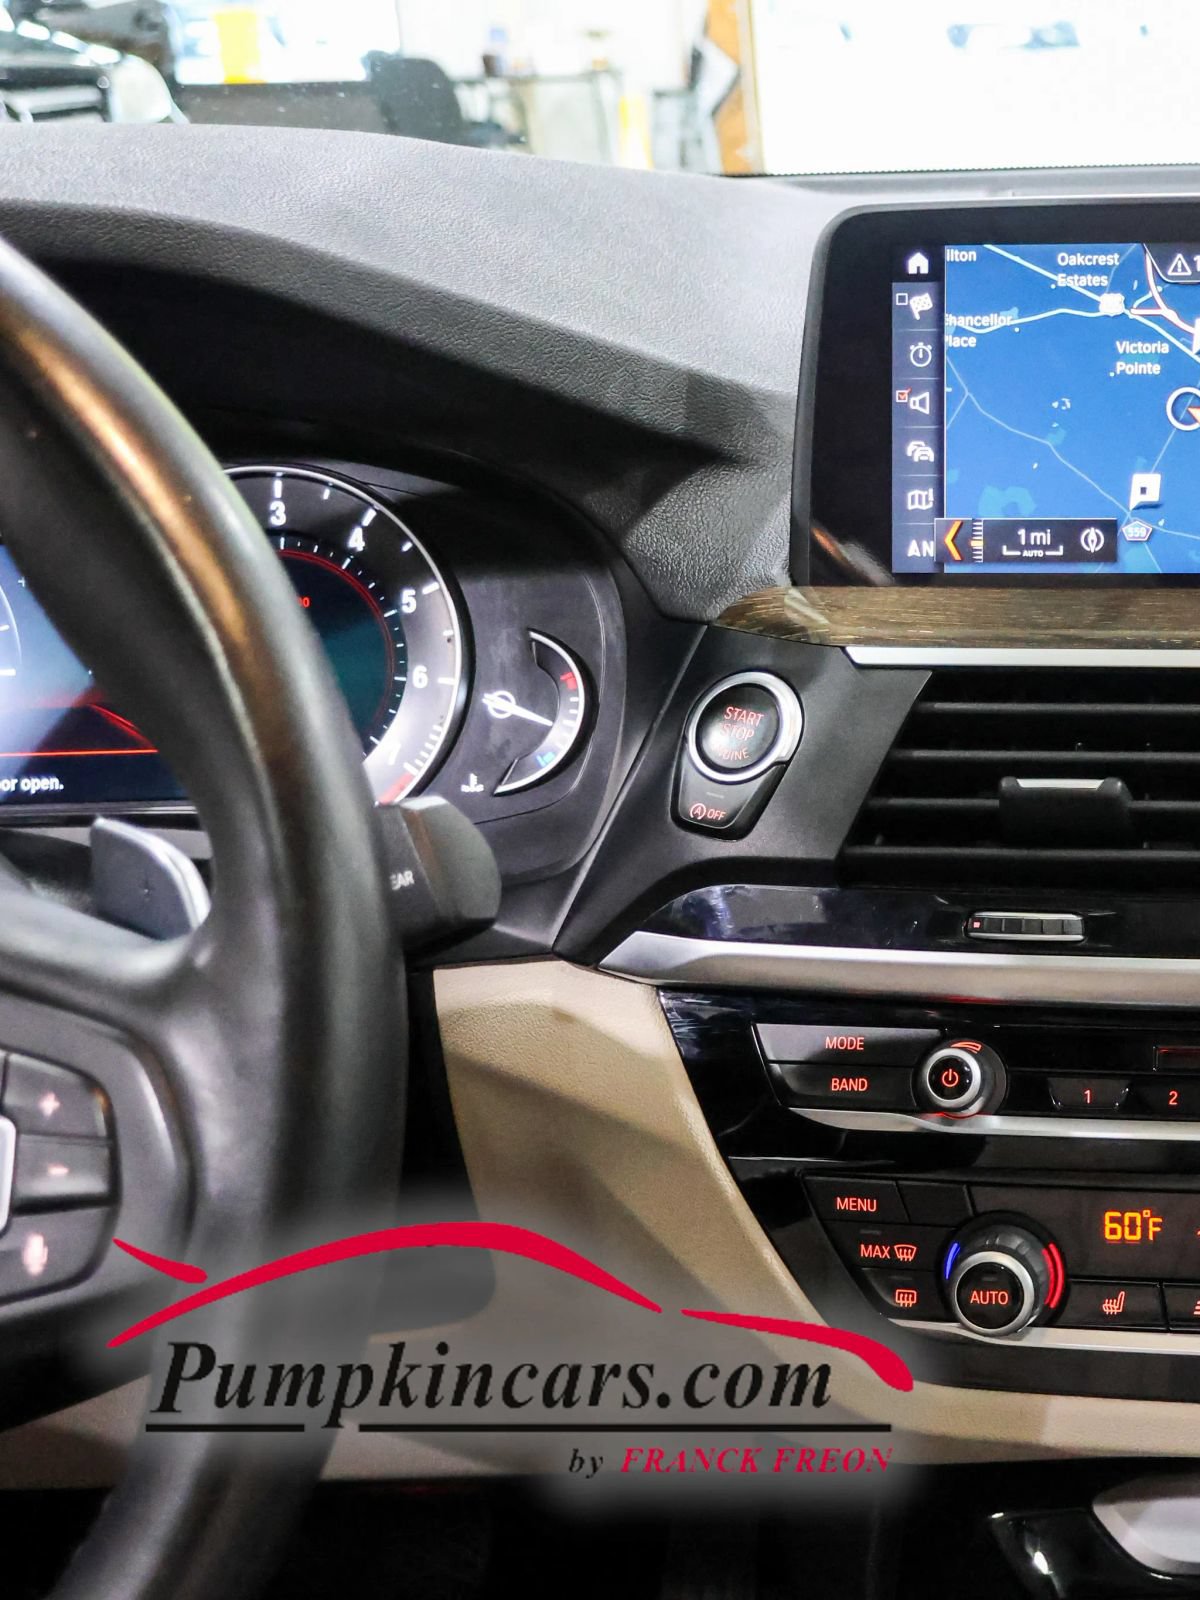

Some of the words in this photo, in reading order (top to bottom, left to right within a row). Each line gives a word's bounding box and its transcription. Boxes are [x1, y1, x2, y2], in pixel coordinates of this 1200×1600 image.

[1057, 252, 1119, 266] Oakcrest
[1193, 255, 1200, 272] 1
[1057, 273, 1109, 287] Estates
[1116, 340, 1169, 354] Victoria
[1116, 361, 1161, 375] Pointe
[269, 500, 287, 526] 3
[349, 526, 366, 552] 4
[1017, 529, 1026, 545] 1
[1030, 529, 1051, 545] mi
[907, 539, 934, 557] AN
[1022, 549, 1044, 558] AUTO
[401, 588, 417, 614] 5
[411, 664, 429, 689] 6
[724, 705, 764, 727] START
[719, 722, 755, 741] STOP
[0, 776, 19, 792] or
[20, 775, 65, 795] open.
[706, 808, 727, 821] OFF
[825, 1036, 865, 1051] MODE
[831, 1077, 868, 1092] BAND
[1083, 1089, 1091, 1104] 1
[1168, 1090, 1178, 1105] 2
[836, 1196, 877, 1212] MENU
[1103, 1209, 1164, 1242] 60°F
[860, 1244, 891, 1259] MAX
[969, 1290, 1009, 1305] AUTO
